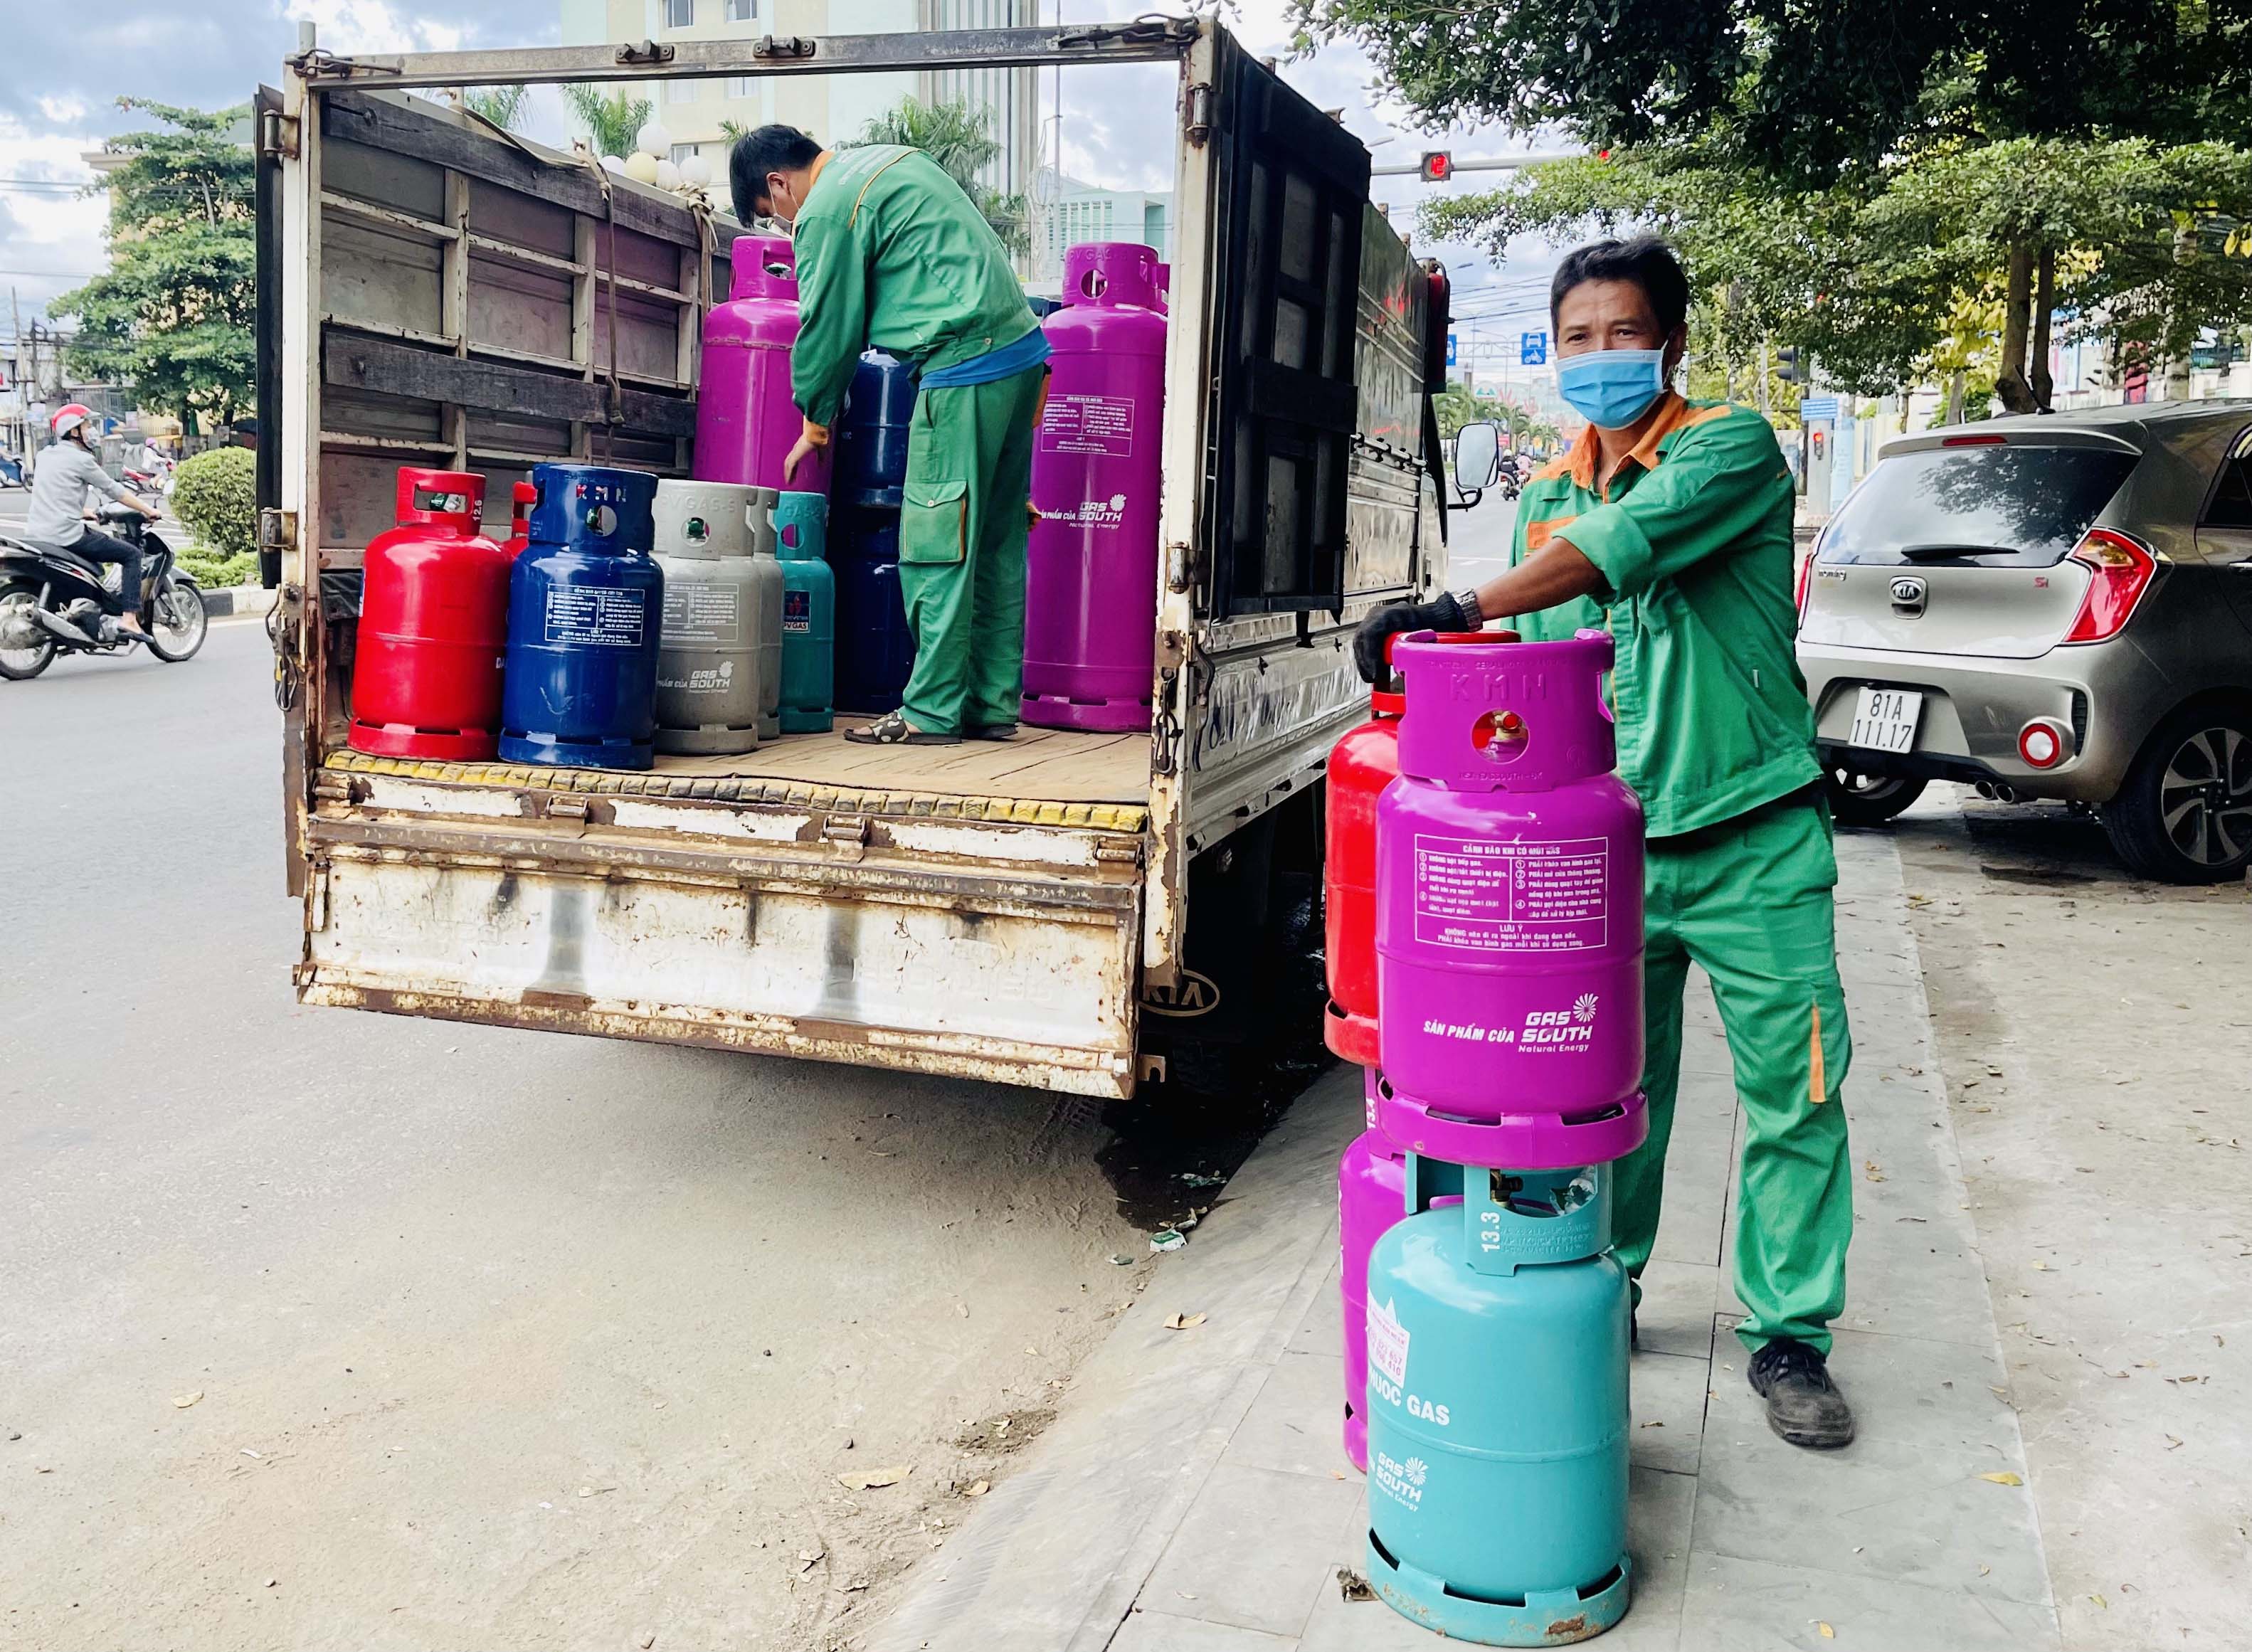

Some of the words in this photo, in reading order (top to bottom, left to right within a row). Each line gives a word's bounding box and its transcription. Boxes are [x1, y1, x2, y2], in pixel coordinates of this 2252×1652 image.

[472, 499, 483, 521] 12.6
[1078, 512, 1122, 521] SOUTH
[1079, 502, 1108, 512] GAS
[1894, 585, 1915, 598] KIA
[689, 678, 731, 689] SOUTH
[691, 669, 718, 679] GAS
[1870, 693, 1903, 721] 81A
[1854, 719, 1913, 750] 111.17
[1525, 1010, 1572, 1027] GAS
[1424, 1018, 1446, 1036] SẢN
[1447, 1022, 1485, 1041] PHẨM
[1488, 1027, 1515, 1044] CỦA
[1521, 1025, 1593, 1044] SOUTH
[1518, 1044, 1556, 1053] Natural
[1559, 1044, 1589, 1053] Energy
[1480, 1212, 1501, 1254] 13.3
[1406, 1394, 1450, 1426] GAS
[1378, 1451, 1404, 1478] GAS
[1377, 1465, 1422, 1503] SOUTH
